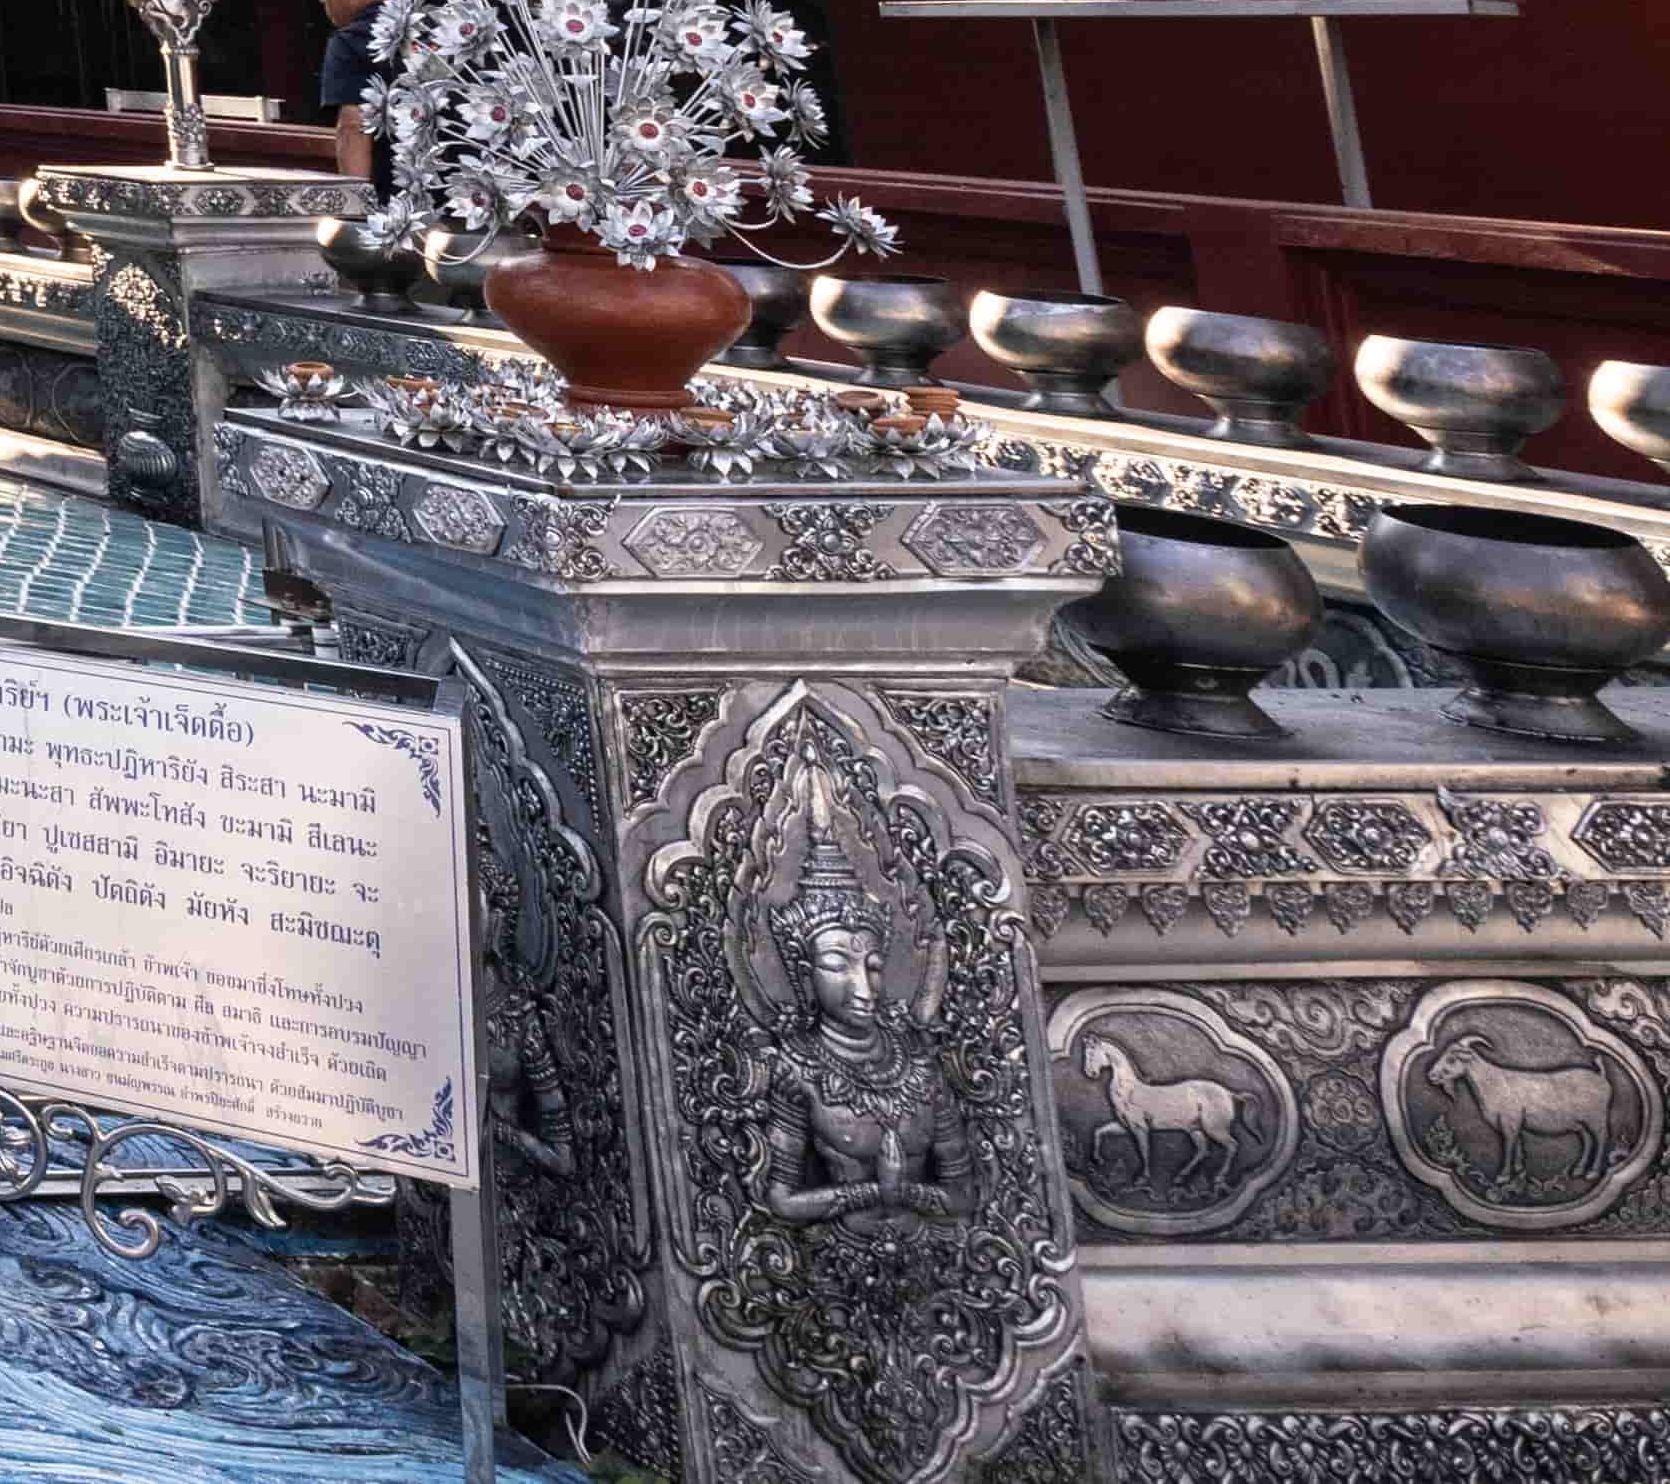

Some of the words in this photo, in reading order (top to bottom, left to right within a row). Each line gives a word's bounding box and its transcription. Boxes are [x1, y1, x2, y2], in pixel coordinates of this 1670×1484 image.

[87, 784, 206, 830] สัพพะโทสัง
[218, 813, 294, 845] ขะมามิ
[218, 762, 286, 800] สิระสา
[296, 782, 376, 816] นะมามิ
[153, 838, 225, 875] อิมายะ
[239, 858, 337, 896] จะริยายะ
[350, 880, 380, 904] จะ
[184, 889, 249, 927] มัยหัง
